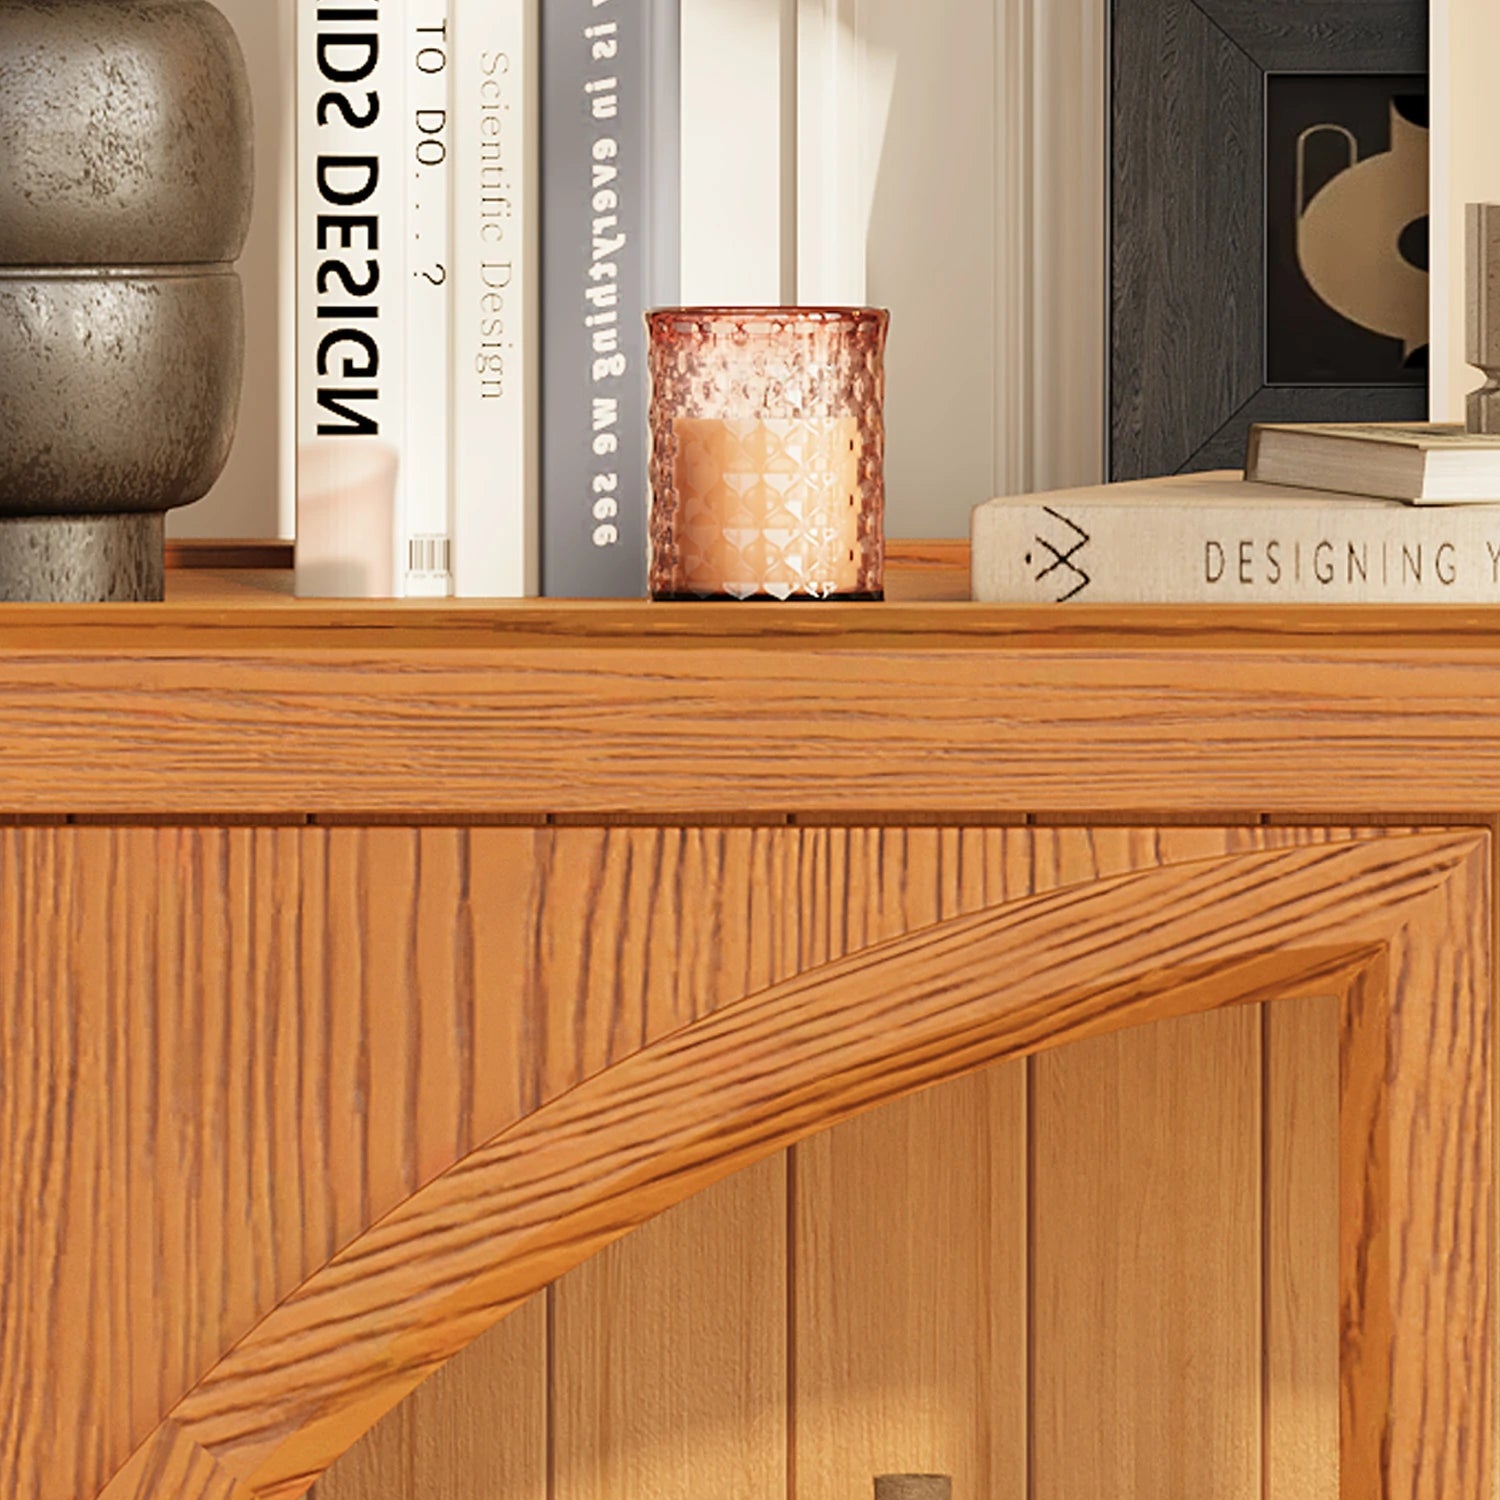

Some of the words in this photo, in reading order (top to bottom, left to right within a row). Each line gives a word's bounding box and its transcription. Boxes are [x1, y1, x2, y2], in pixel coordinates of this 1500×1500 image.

[415, 18, 447, 75] TO
[480, 52, 512, 242] Scientific
[475, 261, 513, 399] Design
[1204, 539, 1456, 587] DESIGNING
